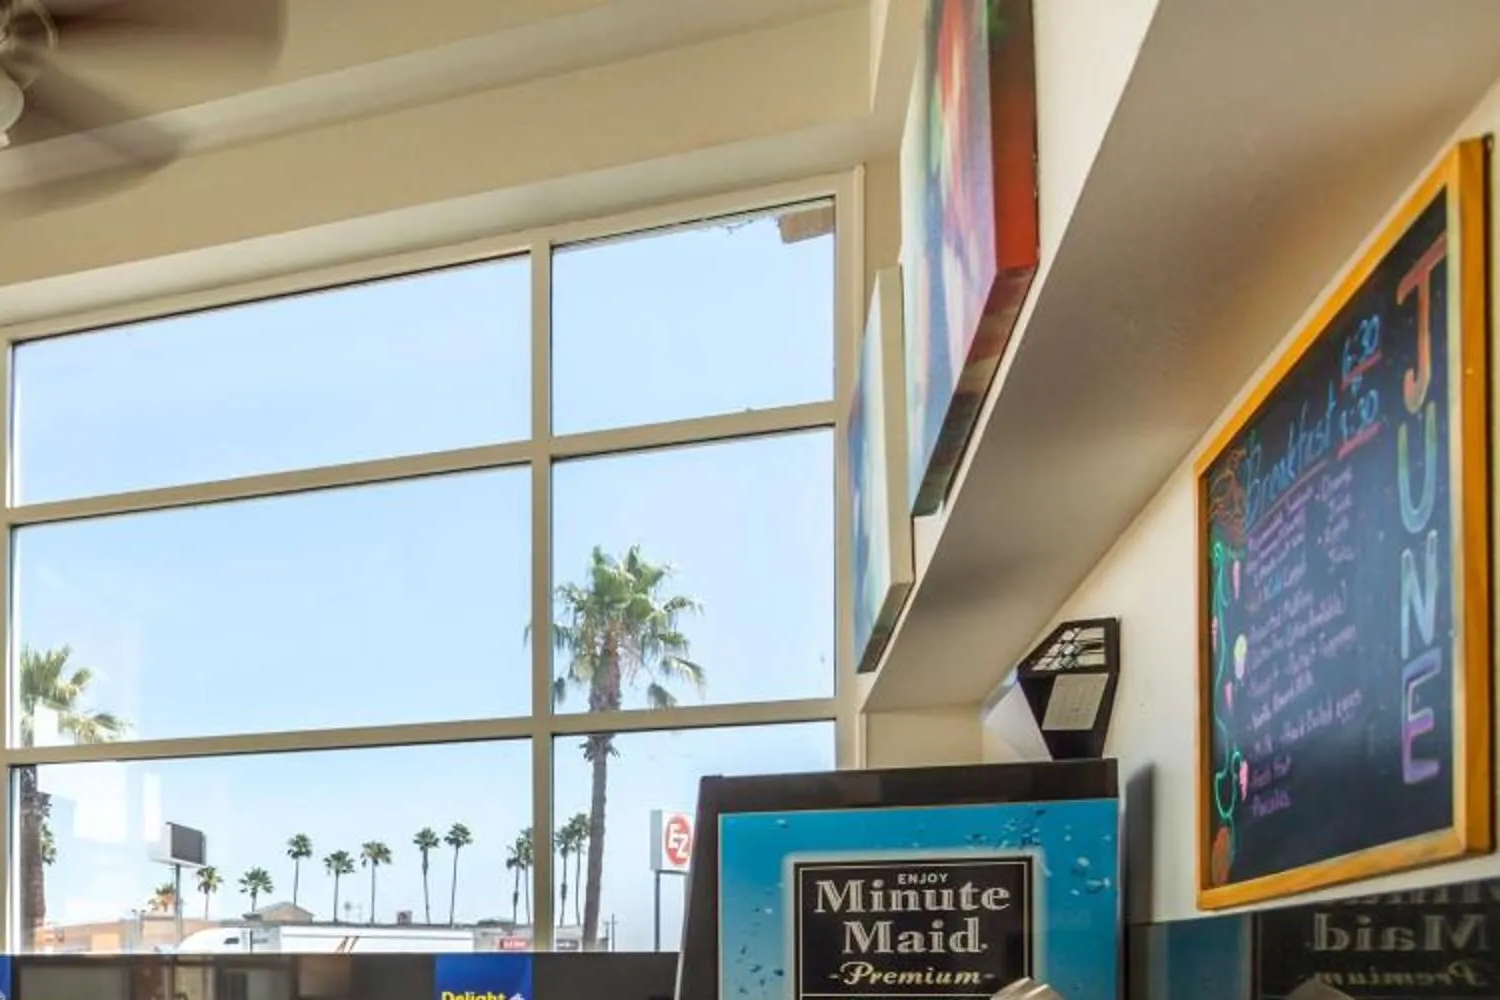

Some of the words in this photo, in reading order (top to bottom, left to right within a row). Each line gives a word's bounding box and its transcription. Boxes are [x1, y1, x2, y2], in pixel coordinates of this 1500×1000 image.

[1398, 234, 1448, 784] JUNE
[813, 879, 1011, 913] Minute
[897, 872, 949, 885] ENJOY
[841, 916, 987, 954] Maid
